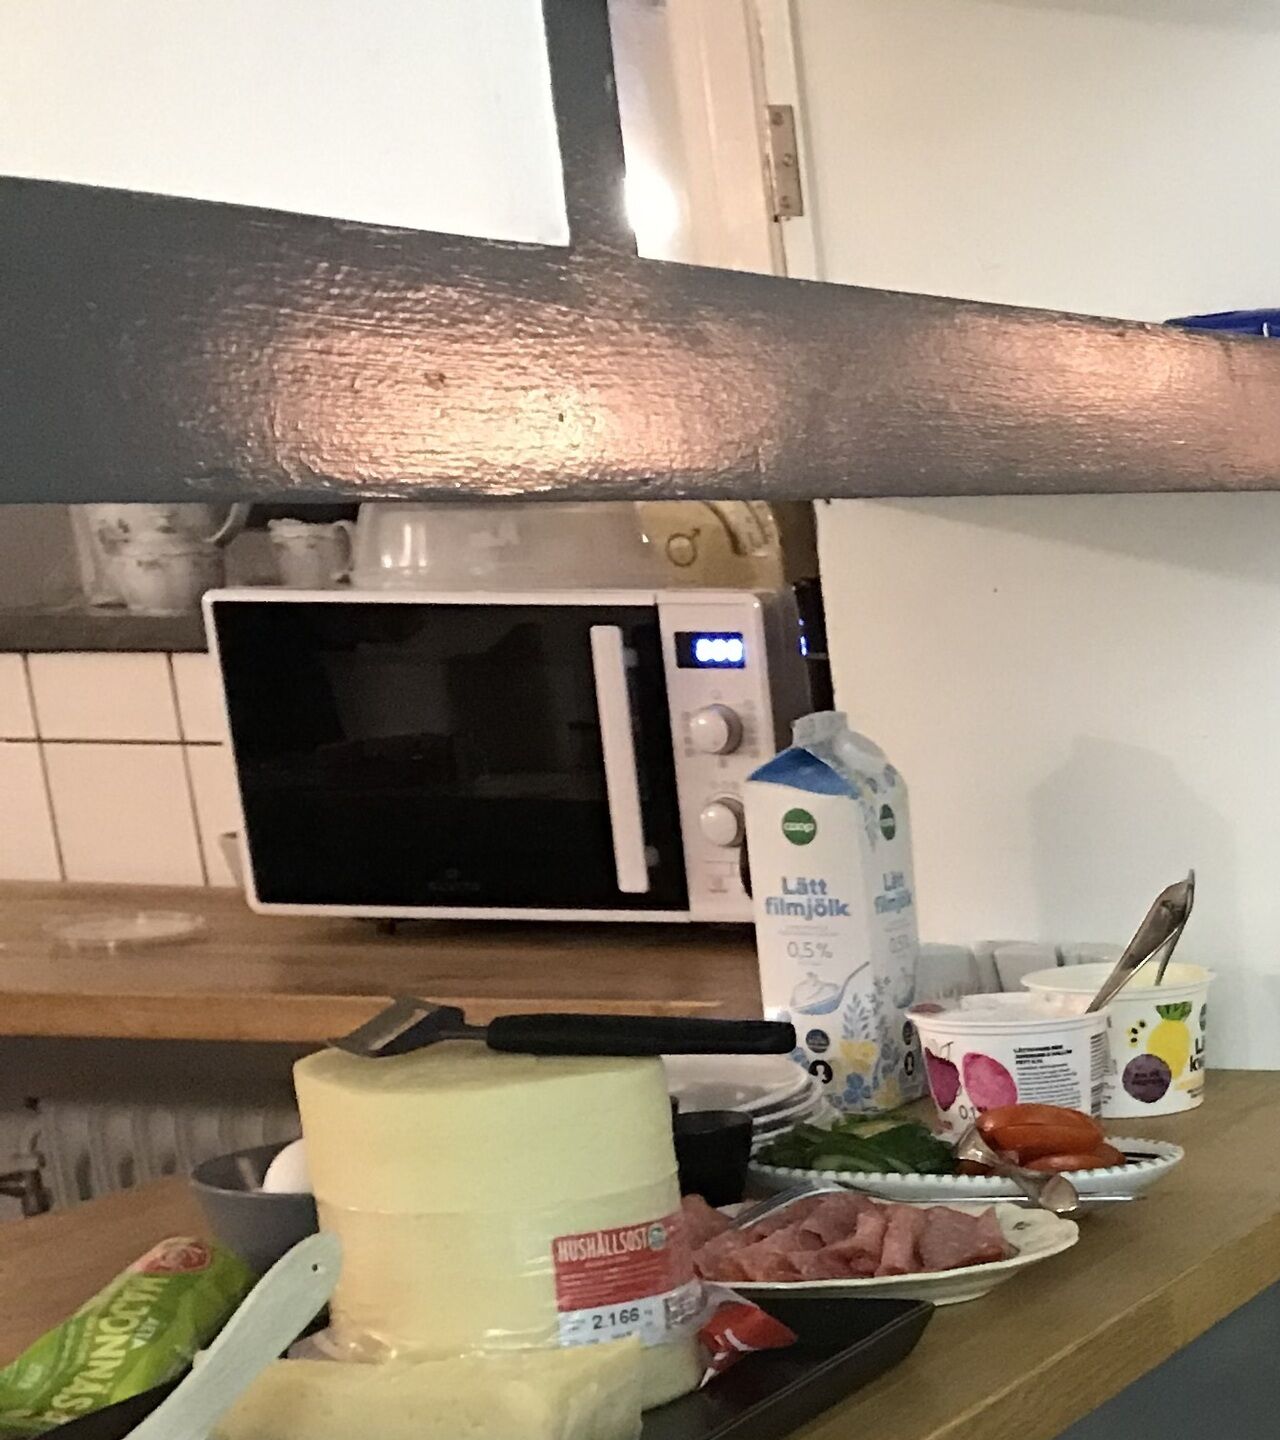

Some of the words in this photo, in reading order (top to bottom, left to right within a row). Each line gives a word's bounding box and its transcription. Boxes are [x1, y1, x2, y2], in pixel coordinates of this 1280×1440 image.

[781, 876, 828, 896] Lätt
[765, 896, 851, 922] filmjölk
[557, 1226, 648, 1263] HUSHÅLLSOST
